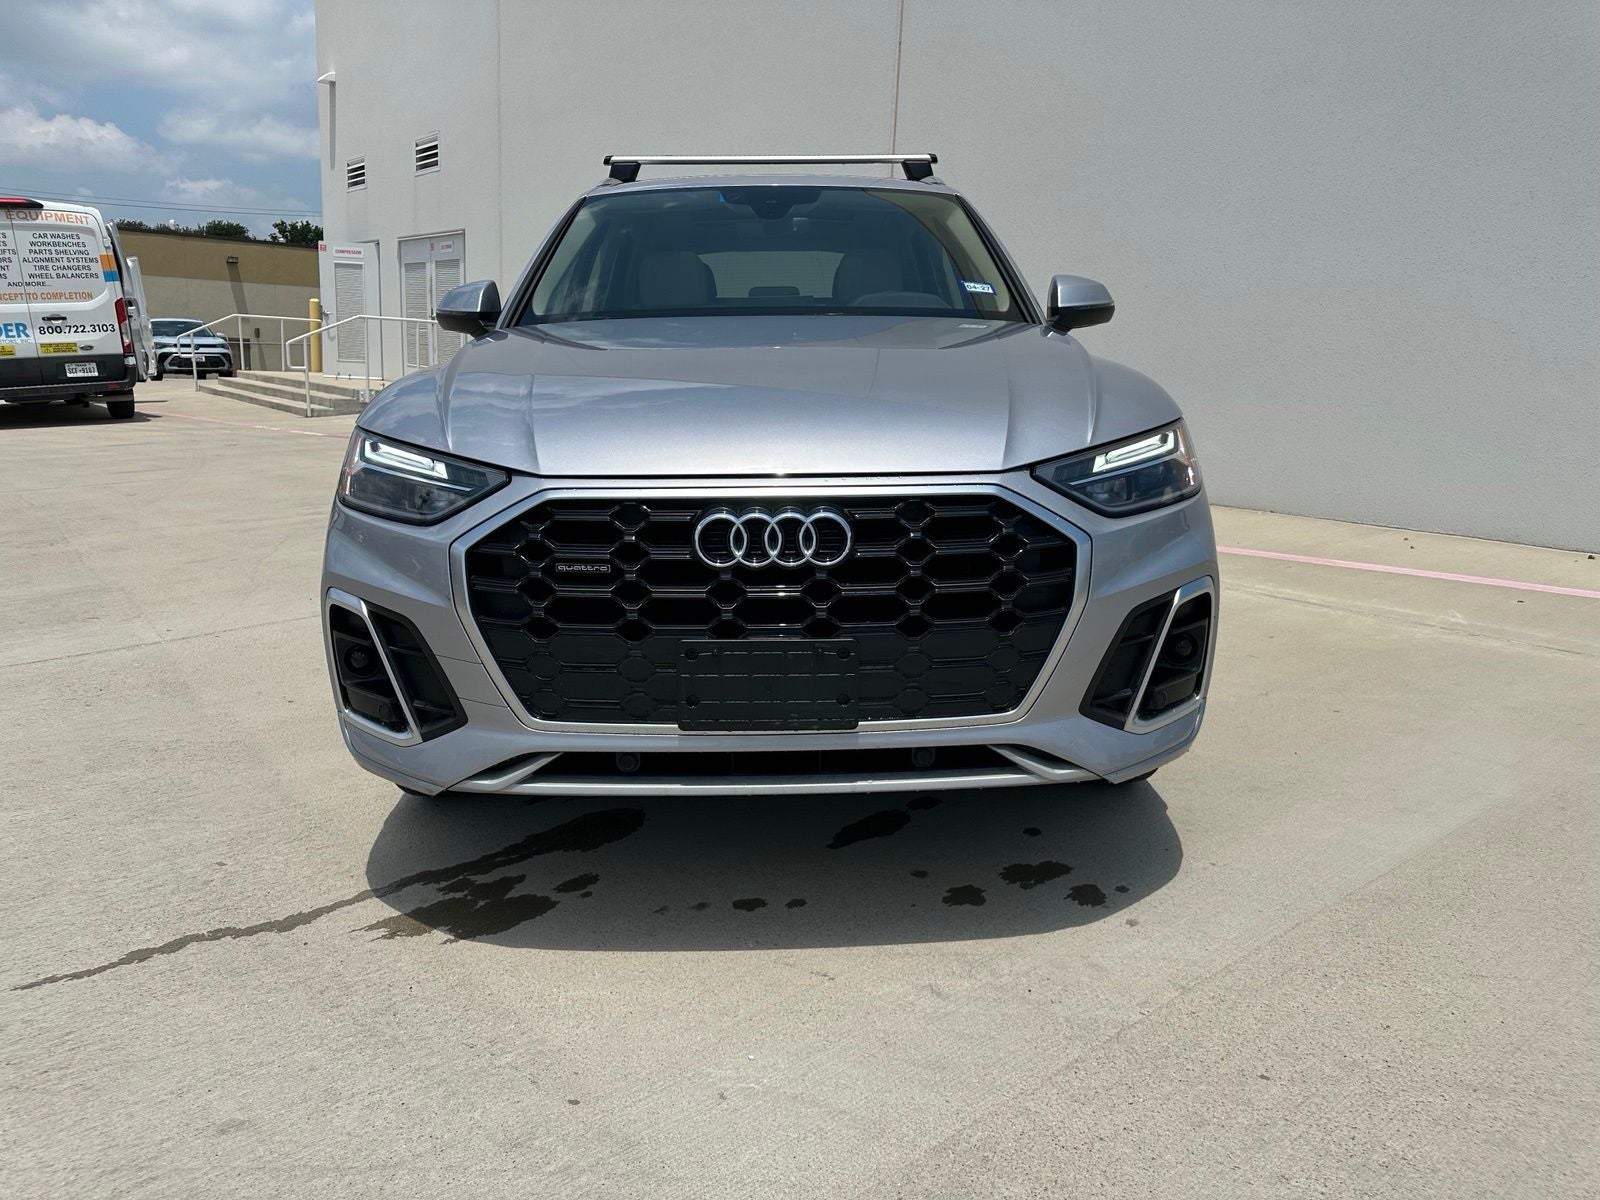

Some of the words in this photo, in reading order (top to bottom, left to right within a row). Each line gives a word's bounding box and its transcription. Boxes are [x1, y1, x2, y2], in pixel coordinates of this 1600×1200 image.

[4, 210, 90, 225] EQUIPMENT
[27, 292, 38, 300] TO
[40, 291, 93, 300] COMPLETION
[39, 323, 116, 335] 800.722.3103
